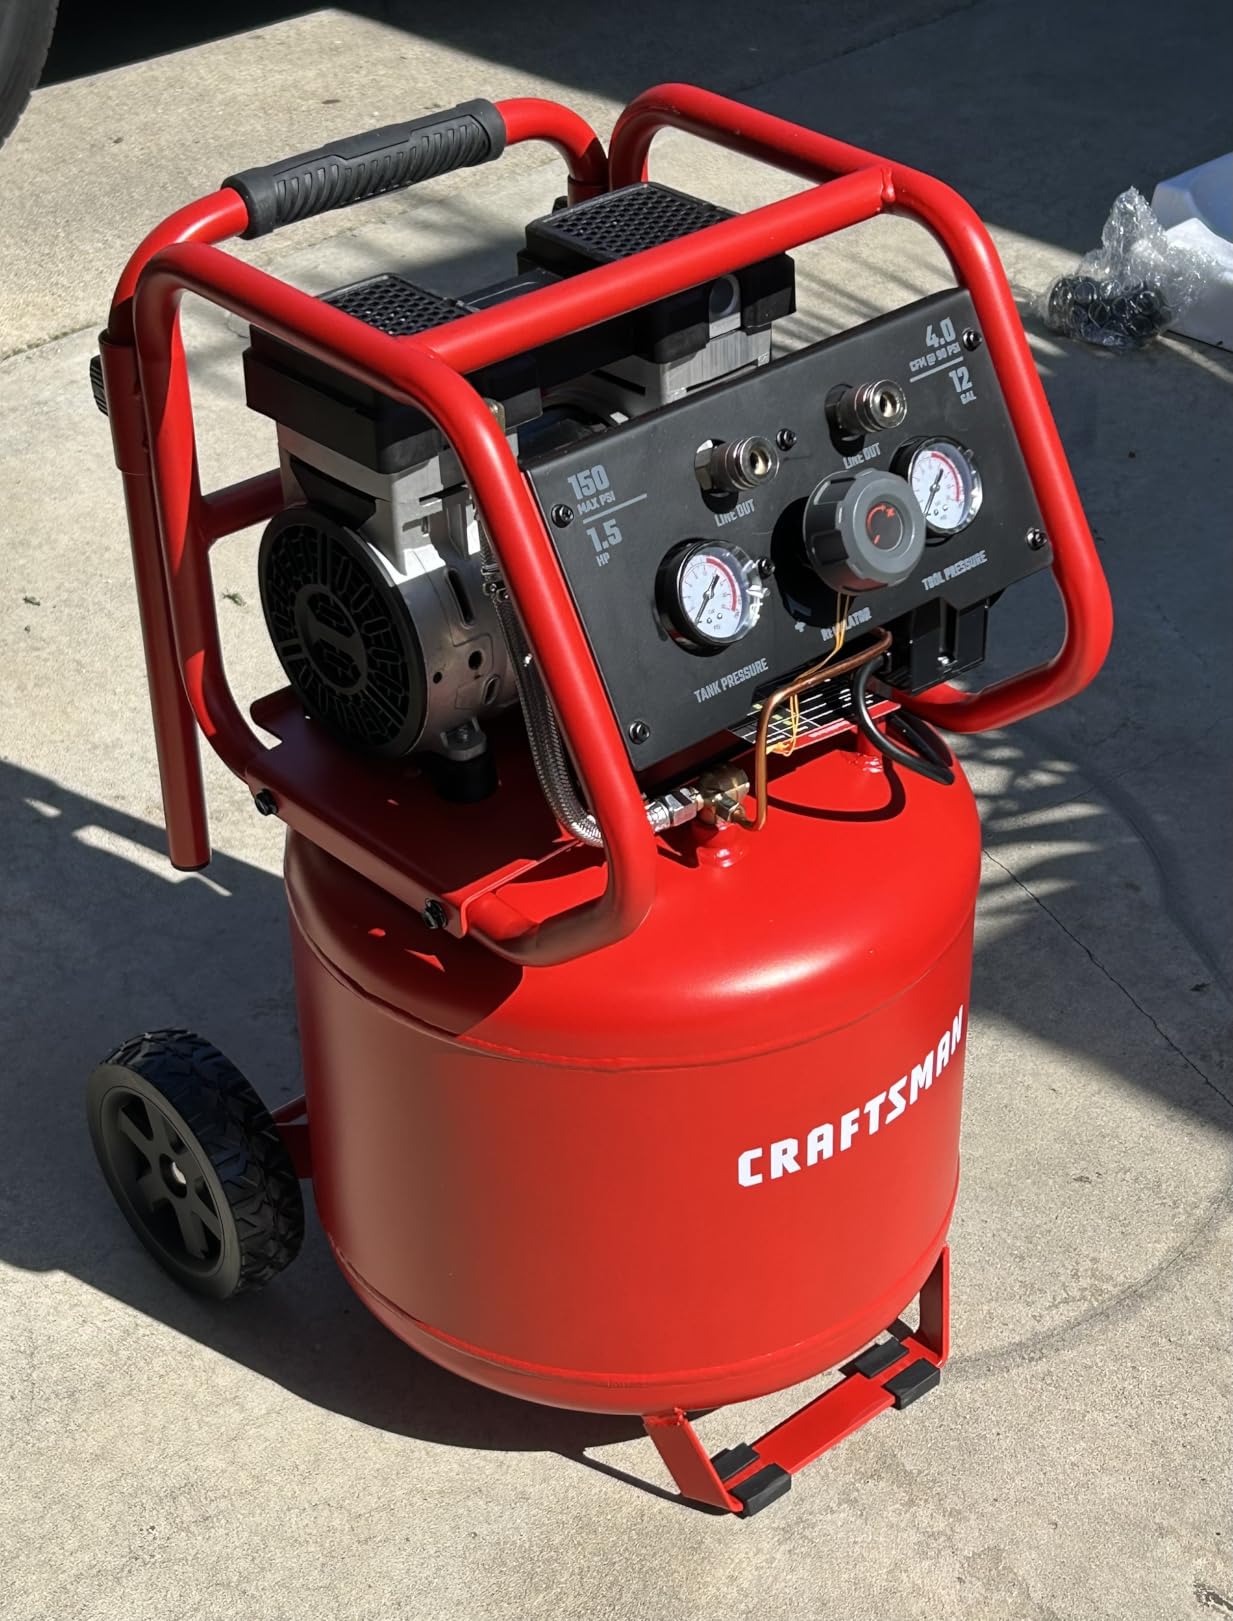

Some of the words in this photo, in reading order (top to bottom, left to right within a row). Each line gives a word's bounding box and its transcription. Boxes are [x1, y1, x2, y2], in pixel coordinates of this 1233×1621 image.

[926, 316, 956, 347] 4.0
[946, 341, 961, 356] PSI
[948, 366, 973, 392] 12
[863, 442, 881, 461] OUT
[567, 464, 610, 500] 150
[577, 497, 600, 516] MAX
[598, 490, 616, 506] PSI
[714, 511, 738, 527] LINE
[735, 498, 755, 518] OUT
[586, 518, 623, 553] 1.5
[595, 551, 611, 567] HP
[921, 571, 946, 591] TOOL
[943, 549, 988, 581] PRESSURE
[693, 680, 722, 703] TANK
[720, 657, 769, 691] PRESSURE
[738, 1004, 964, 1187] CRAFTSMAN
